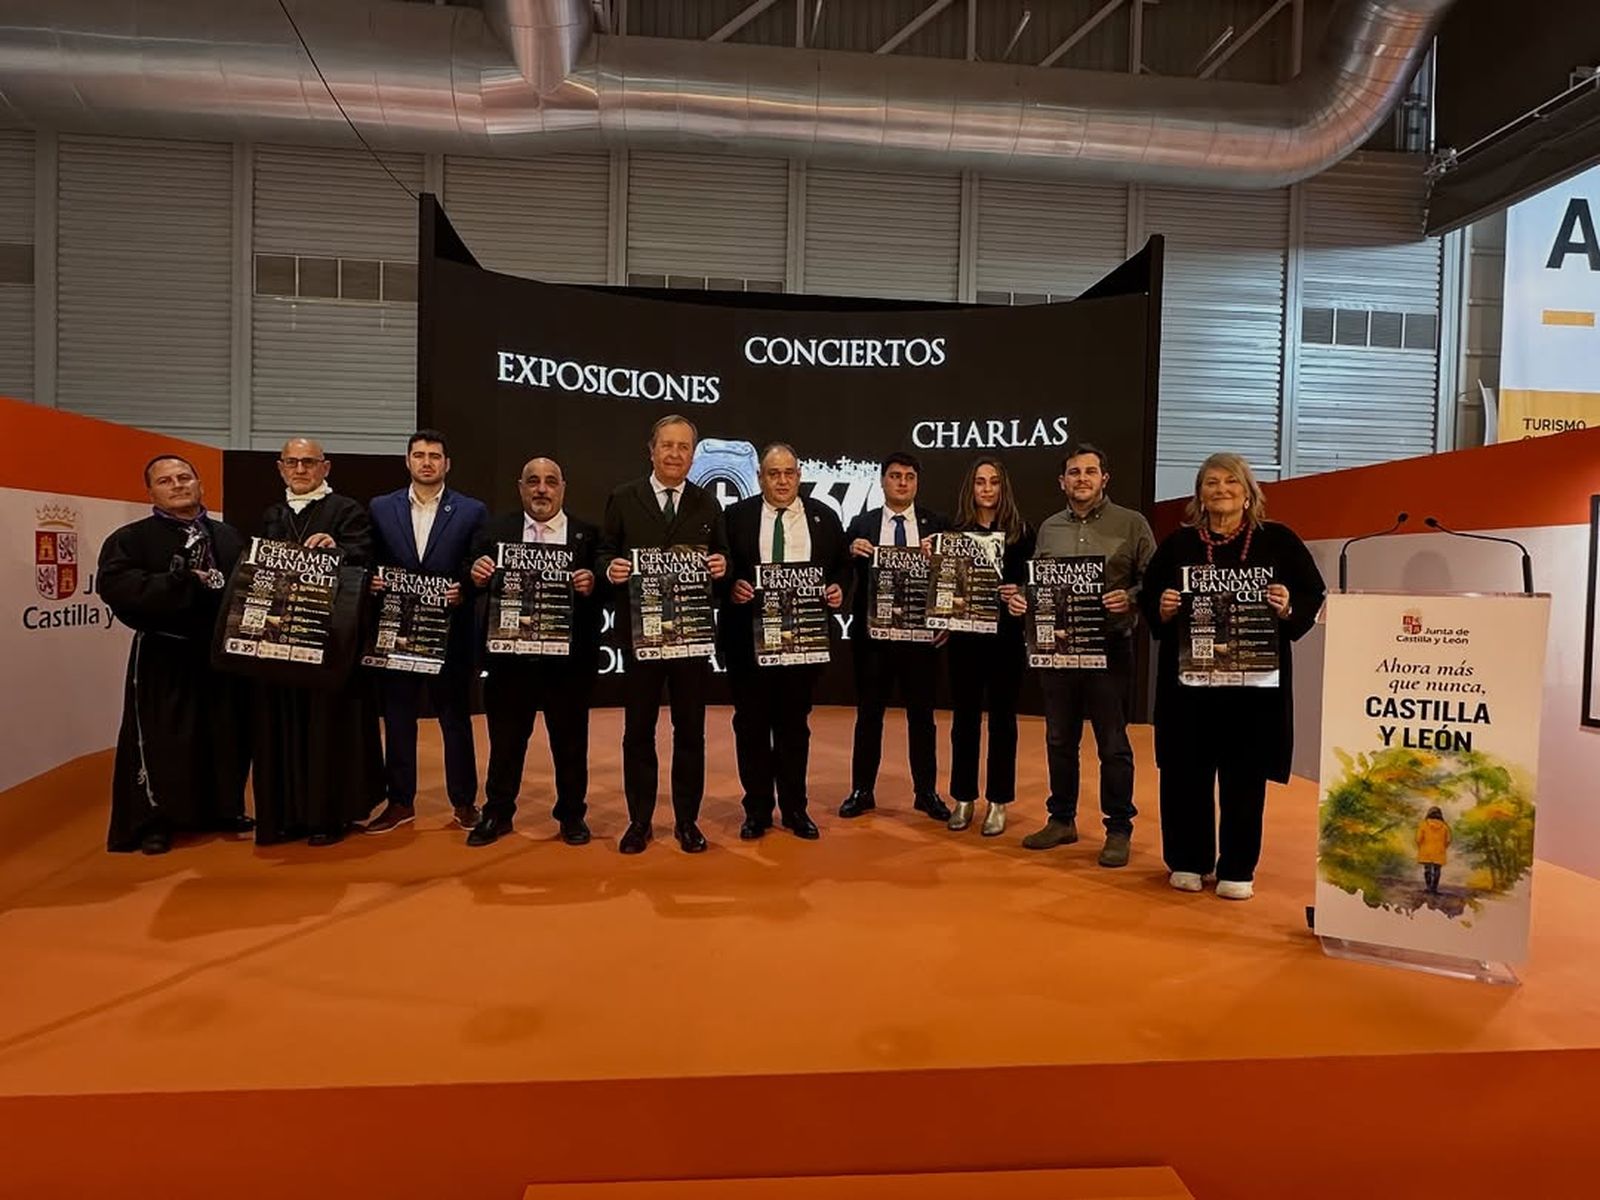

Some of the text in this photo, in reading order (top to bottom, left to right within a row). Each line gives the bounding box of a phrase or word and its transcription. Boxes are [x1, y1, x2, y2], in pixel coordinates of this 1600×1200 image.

[744, 336, 946, 368] CONCIERTOS
[497, 351, 720, 404] EXPOSICIONES
[1522, 417, 1587, 432] TURISMO
[912, 417, 1068, 449] CHARLAS
[260, 545, 340, 566] CERTAMEN
[505, 547, 573, 562] CERTAMEN
[640, 552, 708, 564] CERTAMEN
[266, 558, 324, 574] BANDAS
[511, 560, 561, 571] BANDAS
[648, 563, 697, 574] BANDAS
[762, 567, 823, 579] CERTAMEN
[1036, 562, 1103, 574] CERTAMEN
[385, 571, 452, 588] CERTAMEN
[1042, 573, 1091, 585] BANDAS
[1191, 567, 1274, 581] CERTAMEN
[392, 582, 439, 596] BANDAS
[769, 578, 814, 589] BANDAS
[1200, 579, 1259, 593] BANDAS
[23, 604, 100, 630] Castilla
[833, 614, 854, 640] Y
[1424, 627, 1470, 636] Junta de
[1396, 635, 1469, 645] Castilla y León
[1376, 658, 1474, 676] Ahora más
[1389, 680, 1486, 695] que nunca,
[1366, 696, 1491, 725] CASTILLA
[1379, 724, 1472, 753] Y LEÓN
